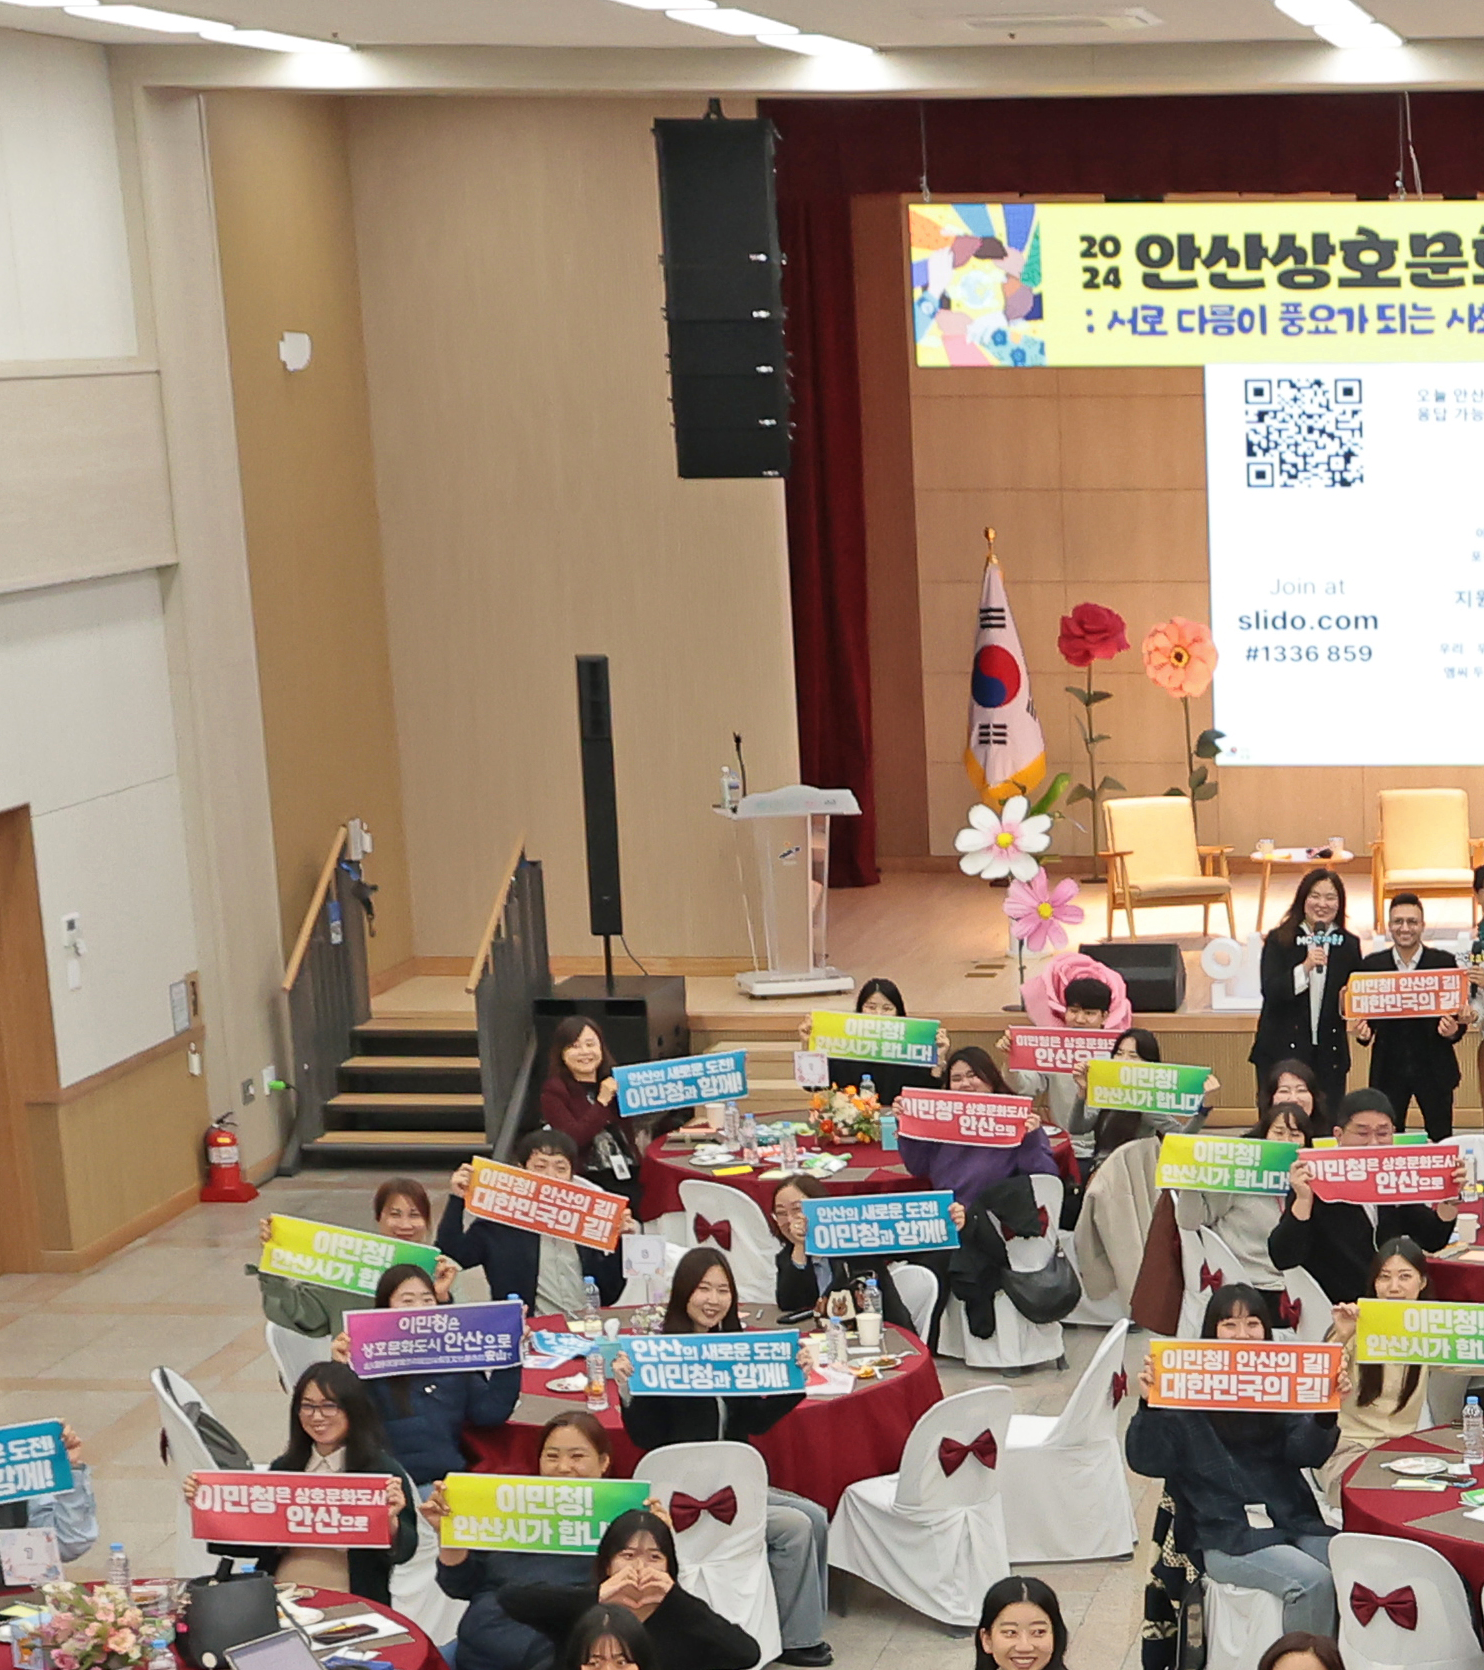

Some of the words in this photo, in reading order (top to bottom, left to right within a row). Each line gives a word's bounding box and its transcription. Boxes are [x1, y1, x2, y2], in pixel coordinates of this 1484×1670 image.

[1107, 303, 1168, 336] 서로
[1177, 303, 1266, 336] 다름이
[1278, 303, 1368, 336] 풍요가
[1377, 302, 1434, 335] 되는
[1270, 578, 1316, 597] Join
[1324, 578, 1346, 596] at
[1238, 610, 1380, 632] slido.com
[1246, 645, 1319, 663] #1336
[1327, 645, 1373, 663] 859
[1351, 992, 1437, 1014] 대한민국의
[1161, 1348, 1231, 1373] 이민청!
[1236, 1349, 1297, 1375] 안산의
[1303, 1350, 1330, 1376] 길!
[1160, 1371, 1289, 1403] 대한민국의
[1296, 1375, 1330, 1404] 길!
[8, 1433, 55, 1464] 도전!
[195, 1484, 291, 1515] 이민청은
[294, 1487, 388, 1507] 상호문화도시
[286, 1505, 369, 1534] 안산으로
